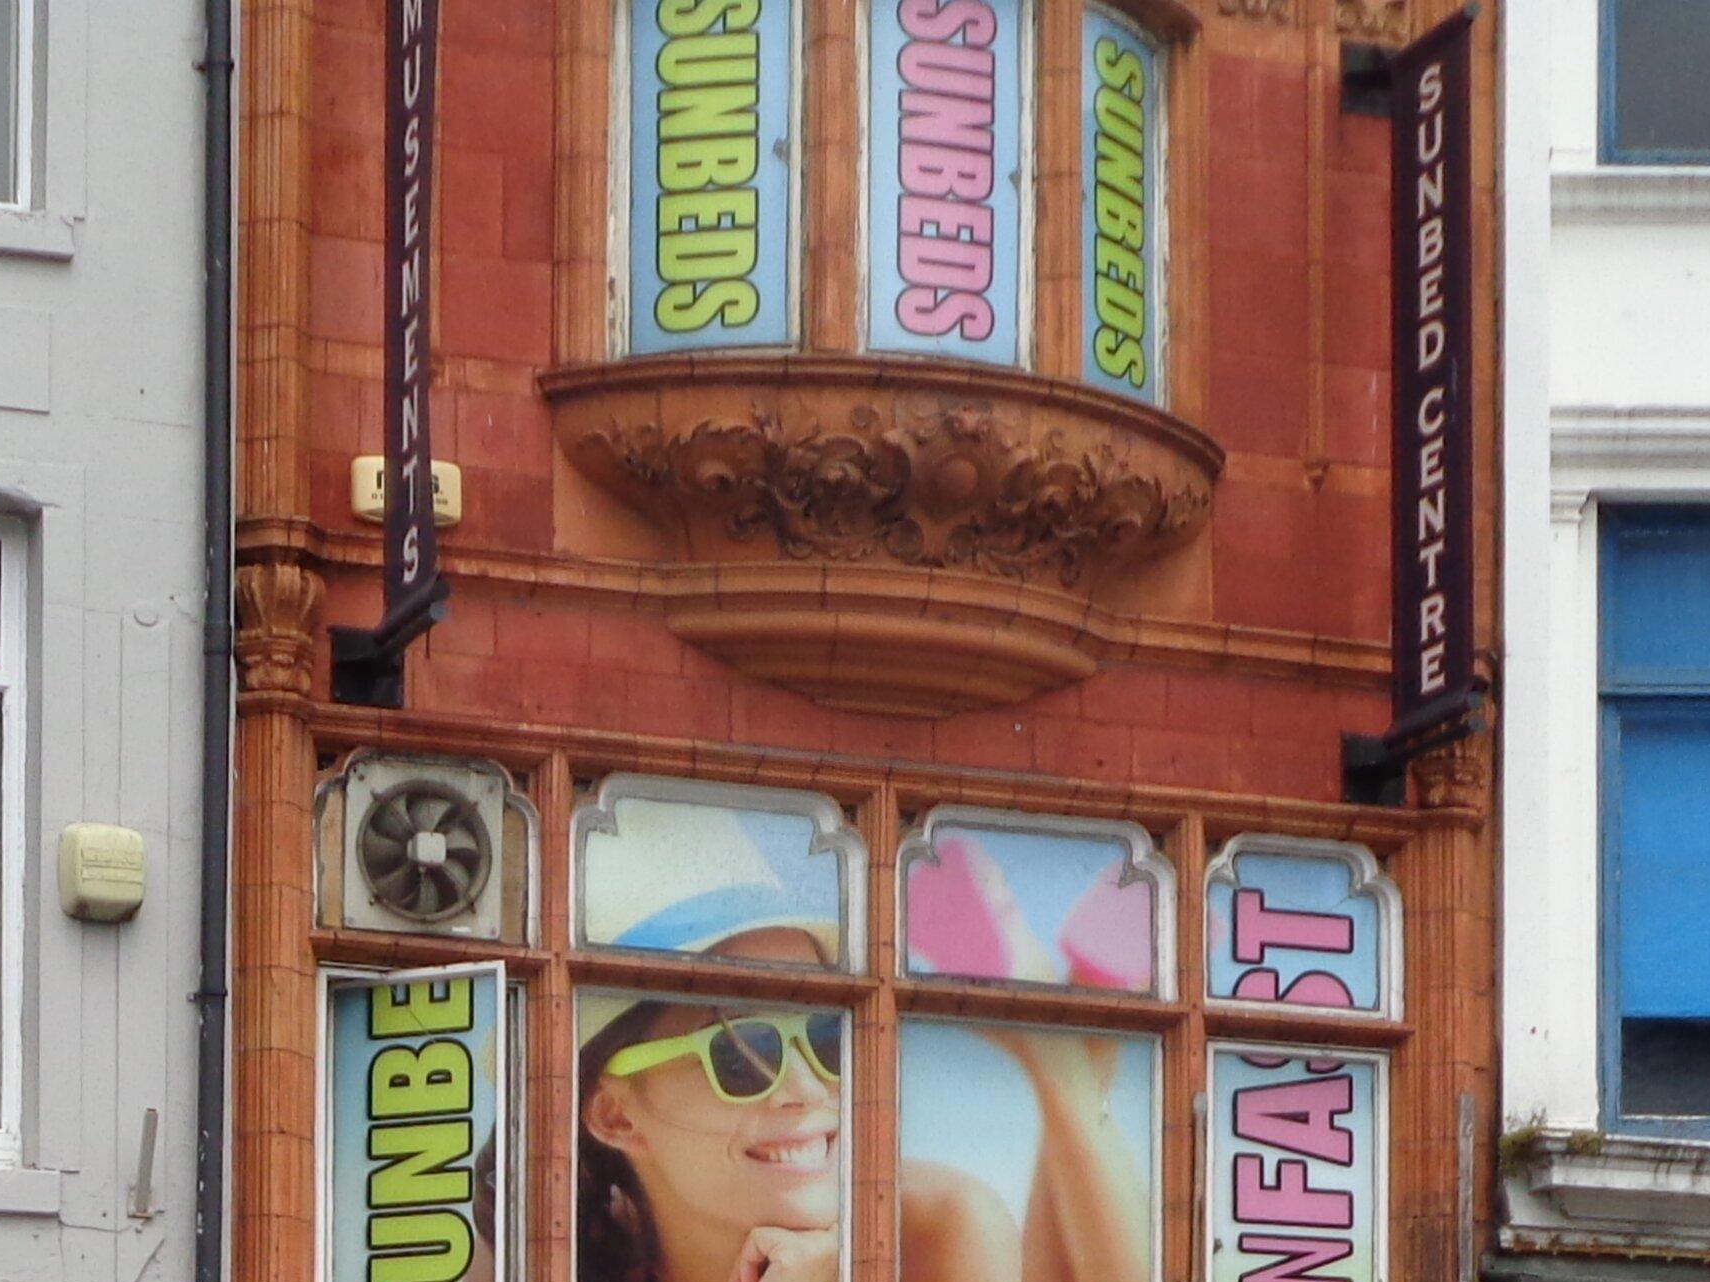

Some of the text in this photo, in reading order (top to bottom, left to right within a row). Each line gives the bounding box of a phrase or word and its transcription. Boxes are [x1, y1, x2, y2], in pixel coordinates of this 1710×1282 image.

[653, 0, 760, 333] SUNBEDS
[893, 0, 995, 344] SUNBEDS
[1092, 36, 1145, 391] SUNBEDS
[1416, 62, 1447, 697] SUNBED CENTRE
